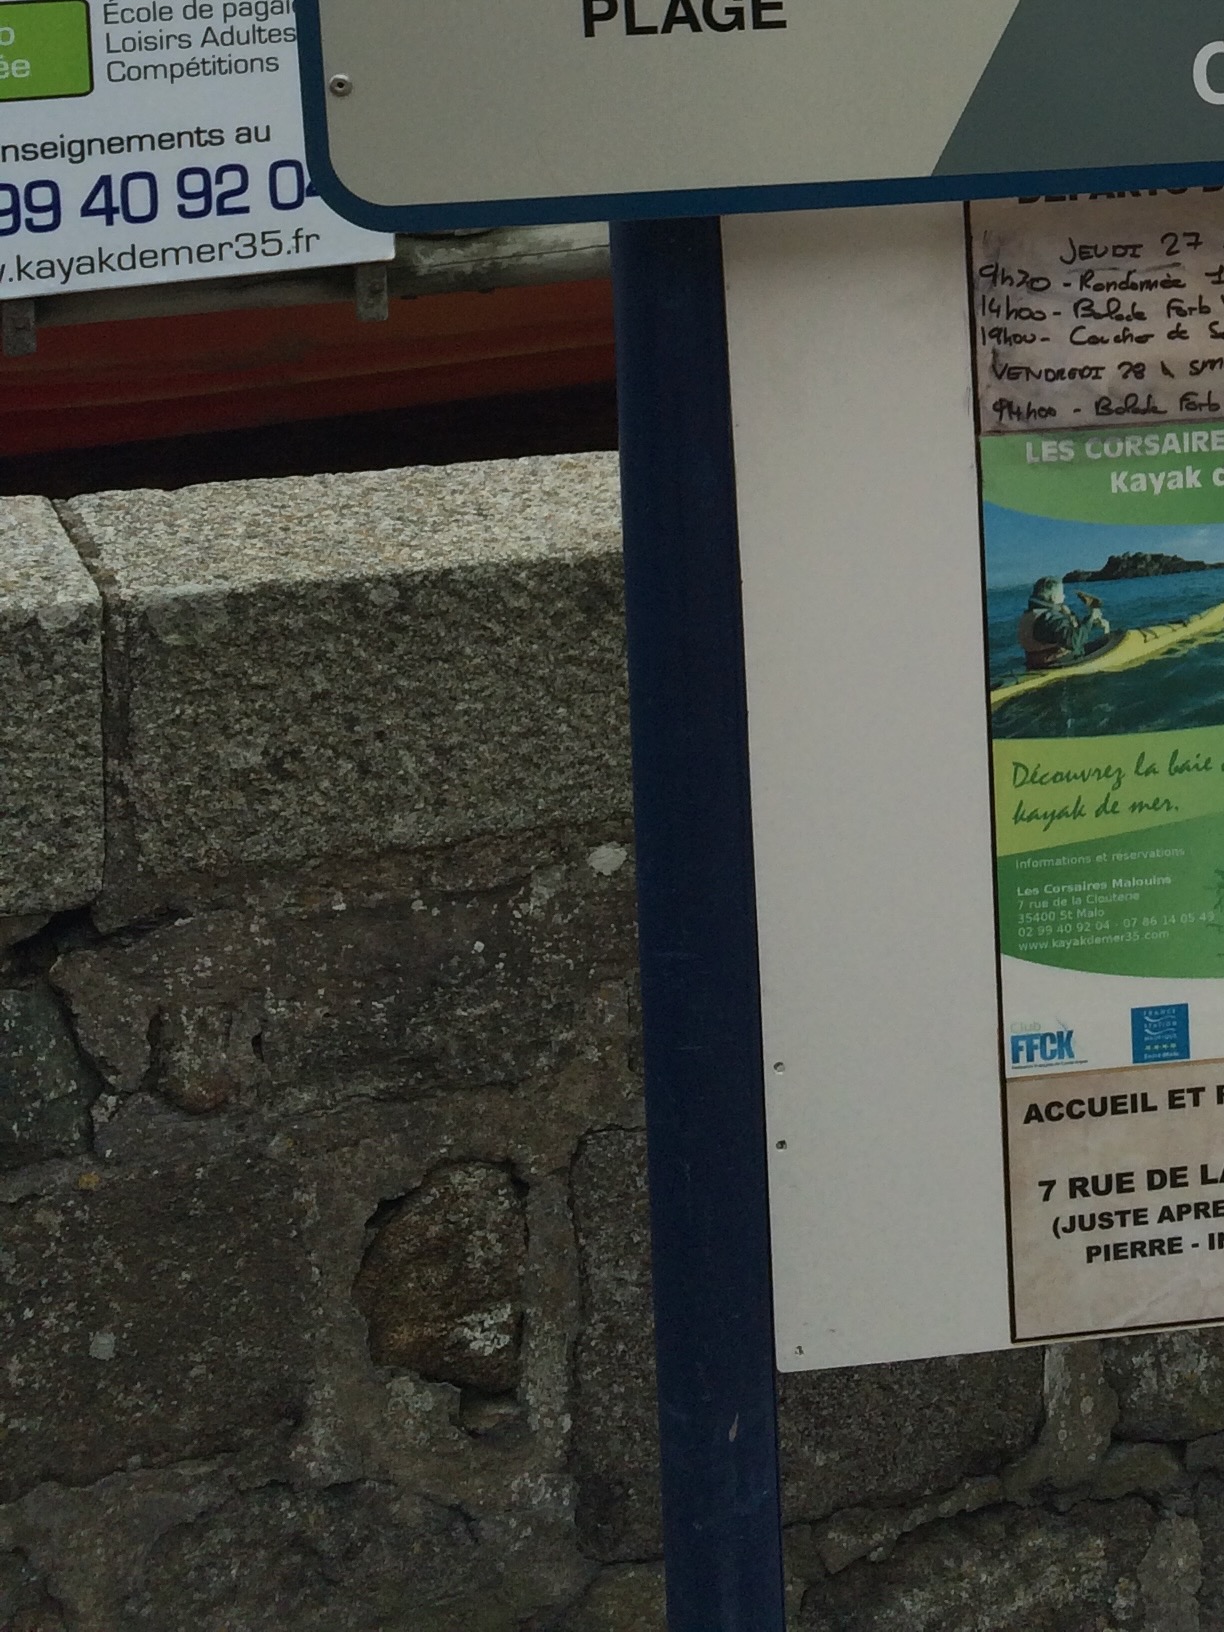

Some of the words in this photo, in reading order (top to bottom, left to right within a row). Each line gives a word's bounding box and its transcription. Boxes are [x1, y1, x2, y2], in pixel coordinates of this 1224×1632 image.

[106, 27, 192, 54] Loisirs
[201, 23, 297, 48] Adultes
[107, 52, 280, 85] Compétitions
[234, 123, 271, 146] au
[80, 170, 159, 227] 40
[177, 163, 251, 219] 92
[1059, 236, 1144, 266] JEUDI
[1160, 231, 1204, 257] 27
[1166, 322, 1190, 341] de
[992, 362, 1106, 383] VENDREDI
[1026, 438, 1075, 465] LES
[1110, 463, 1202, 496] Kayak
[1012, 760, 1126, 792] Découvrez
[1133, 751, 1160, 777] la
[1168, 748, 1214, 777] baie
[1012, 794, 1087, 833] kayak
[1094, 791, 1120, 819] de
[1128, 796, 1180, 815] mer.
[1095, 851, 1108, 863] et
[1016, 885, 1040, 897] Les
[1029, 899, 1050, 910] rue
[1052, 896, 1068, 908] de
[1071, 895, 1083, 906] la
[1059, 910, 1074, 921] St
[1076, 907, 1106, 919] Malo
[1076, 922, 1092, 933] 92
[1123, 918, 1138, 930] 07
[1010, 1029, 1075, 1065] FFCK
[1023, 1092, 1158, 1124] ACCUEIL
[1167, 1086, 1206, 1111] ET
[1038, 1180, 1057, 1202] 7
[1067, 1171, 1136, 1200] RUE
[1146, 1164, 1190, 1192] DE
[1051, 1206, 1149, 1240] (JUSTE
[1085, 1235, 1185, 1265] PIERRE
